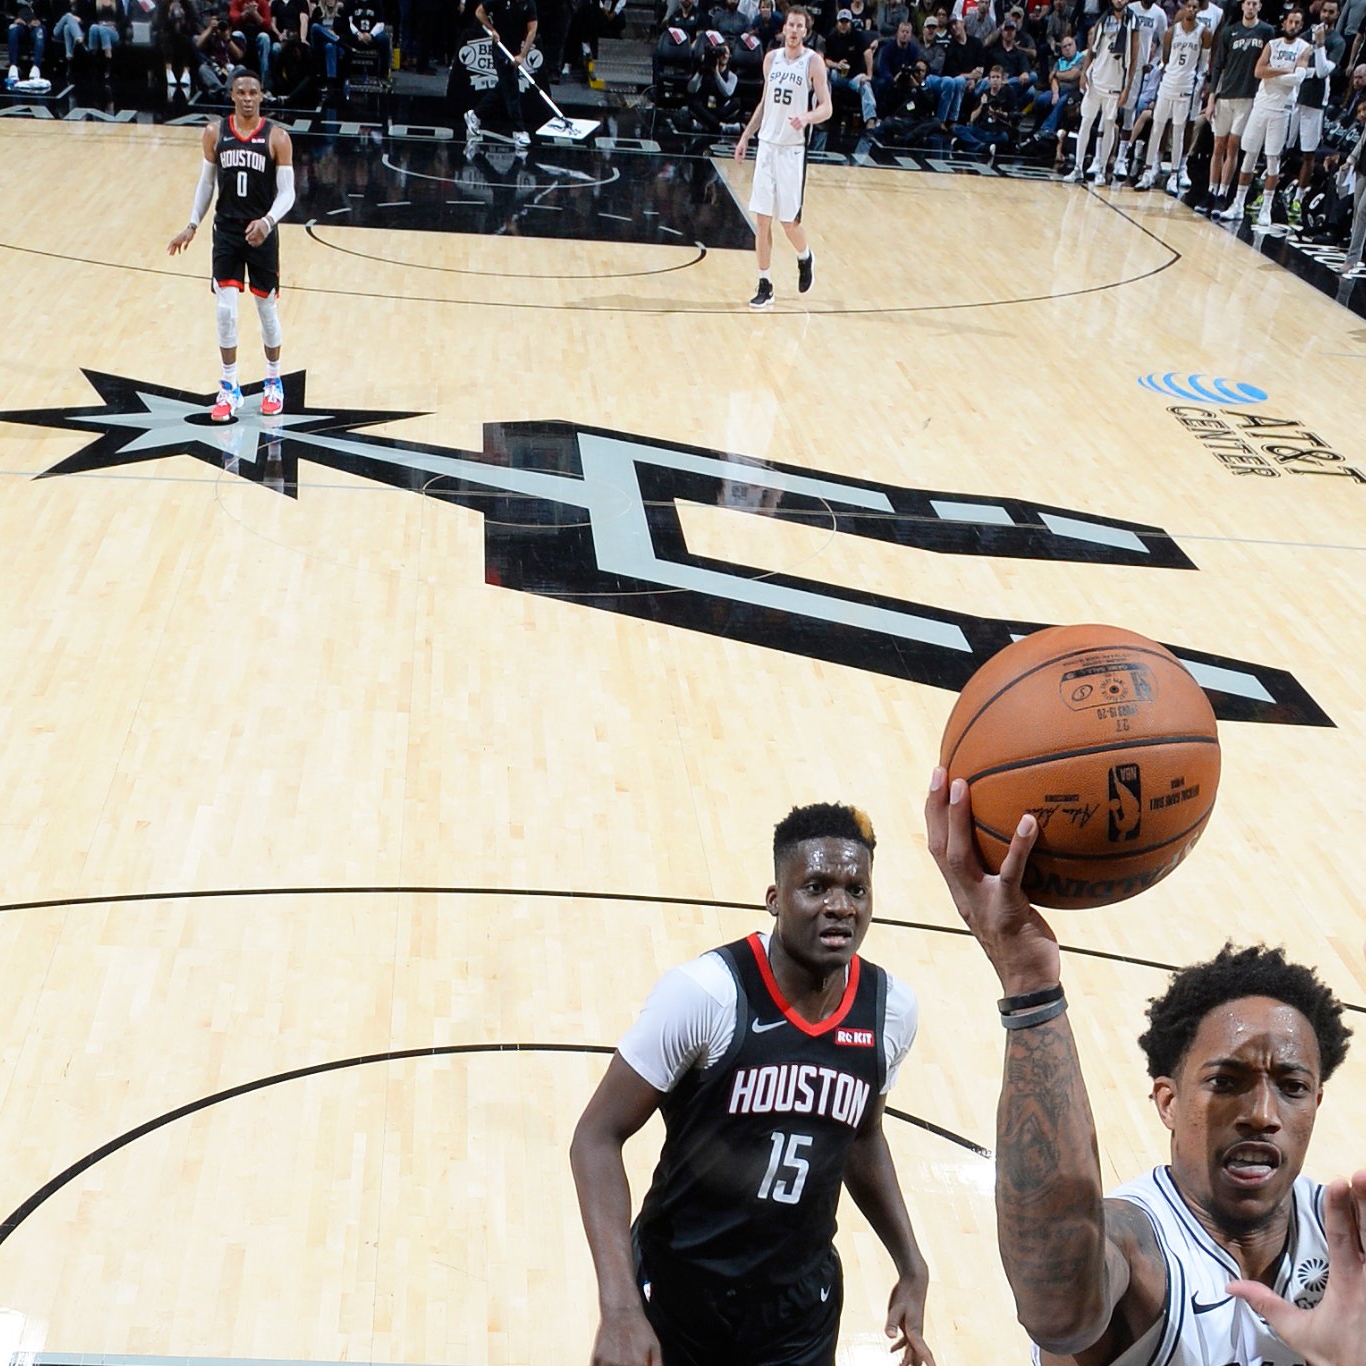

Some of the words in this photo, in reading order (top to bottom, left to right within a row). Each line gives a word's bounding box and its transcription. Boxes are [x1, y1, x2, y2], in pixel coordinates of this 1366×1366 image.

[1178, 54, 1187, 66] 5
[770, 71, 803, 86] SPURS
[774, 88, 793, 105] 25
[220, 149, 266, 173] HOUSTON
[237, 171, 248, 197] 0
[1166, 406, 1282, 478] CENTER
[1120, 767, 1136, 780] NBA
[729, 1065, 870, 1129] HOUSTON
[757, 1131, 813, 1205] 15
